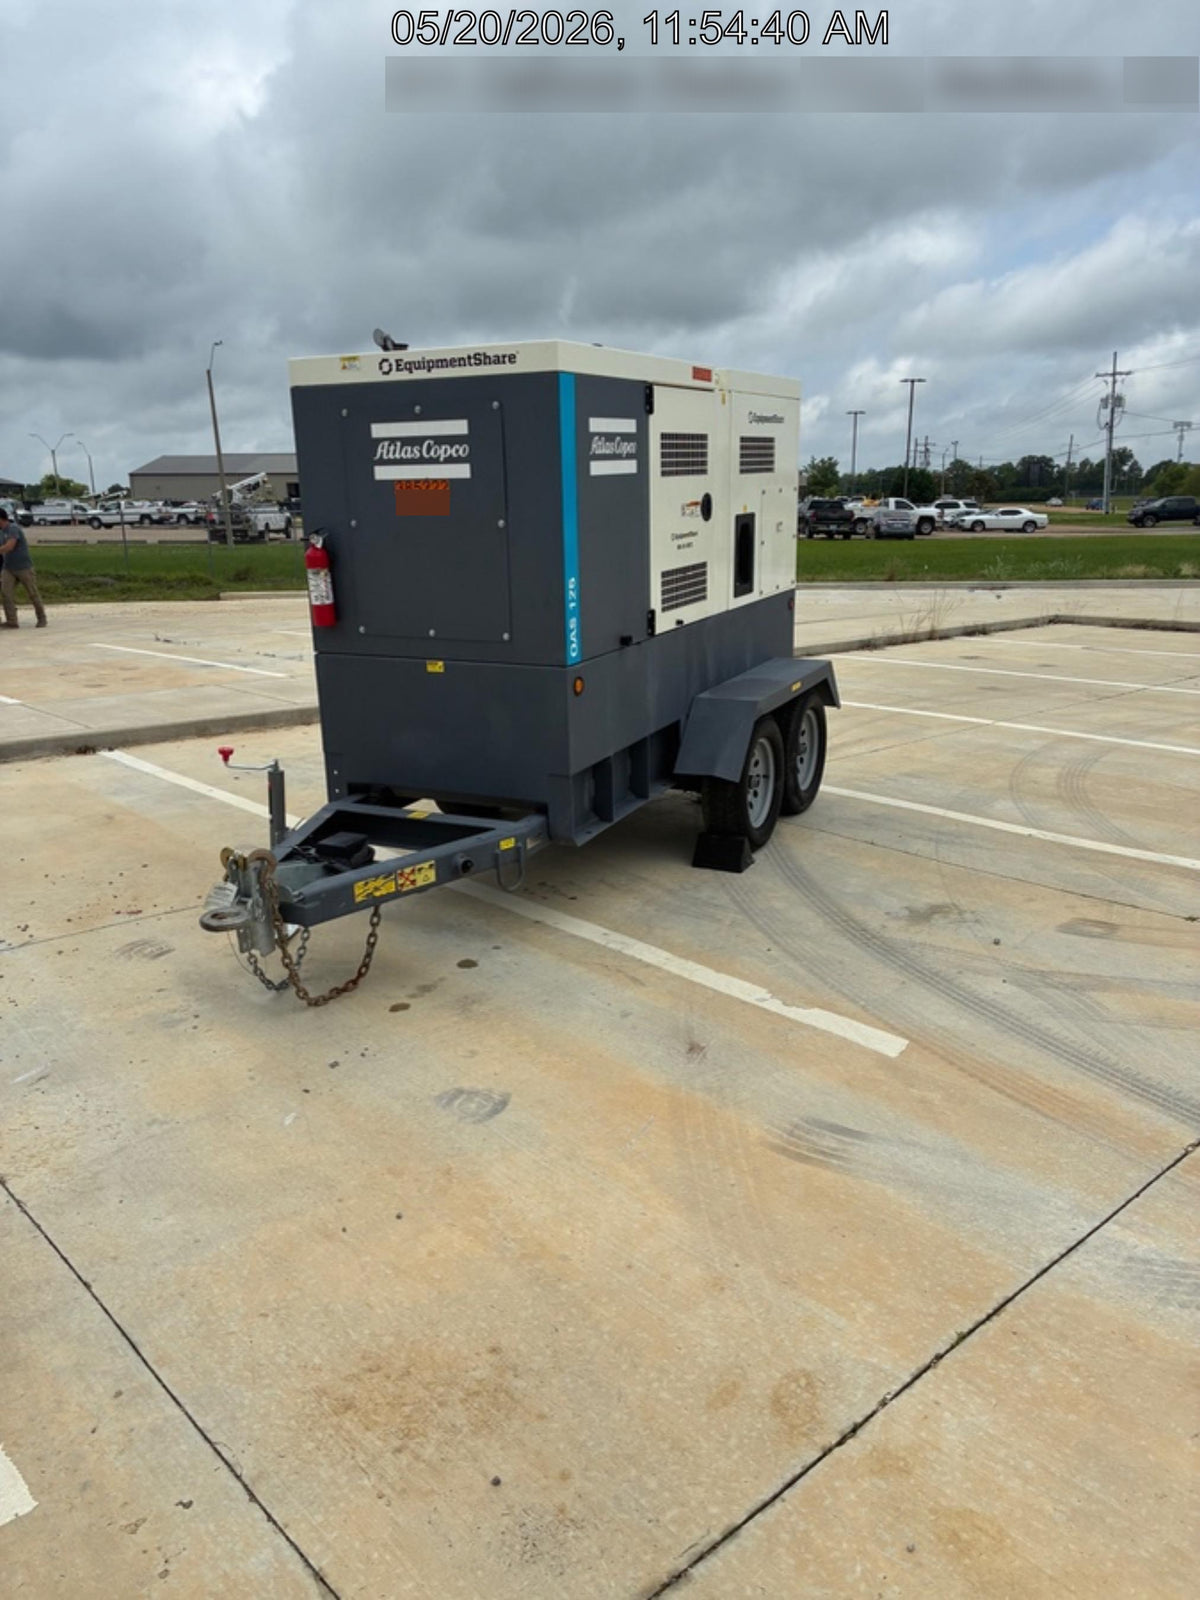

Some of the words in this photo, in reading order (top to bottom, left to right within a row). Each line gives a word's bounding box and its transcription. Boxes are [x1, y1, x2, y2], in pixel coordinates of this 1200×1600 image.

[395, 352, 517, 373] EquipmentShare
[374, 440, 421, 461] Atlas
[422, 439, 470, 462] Copco
